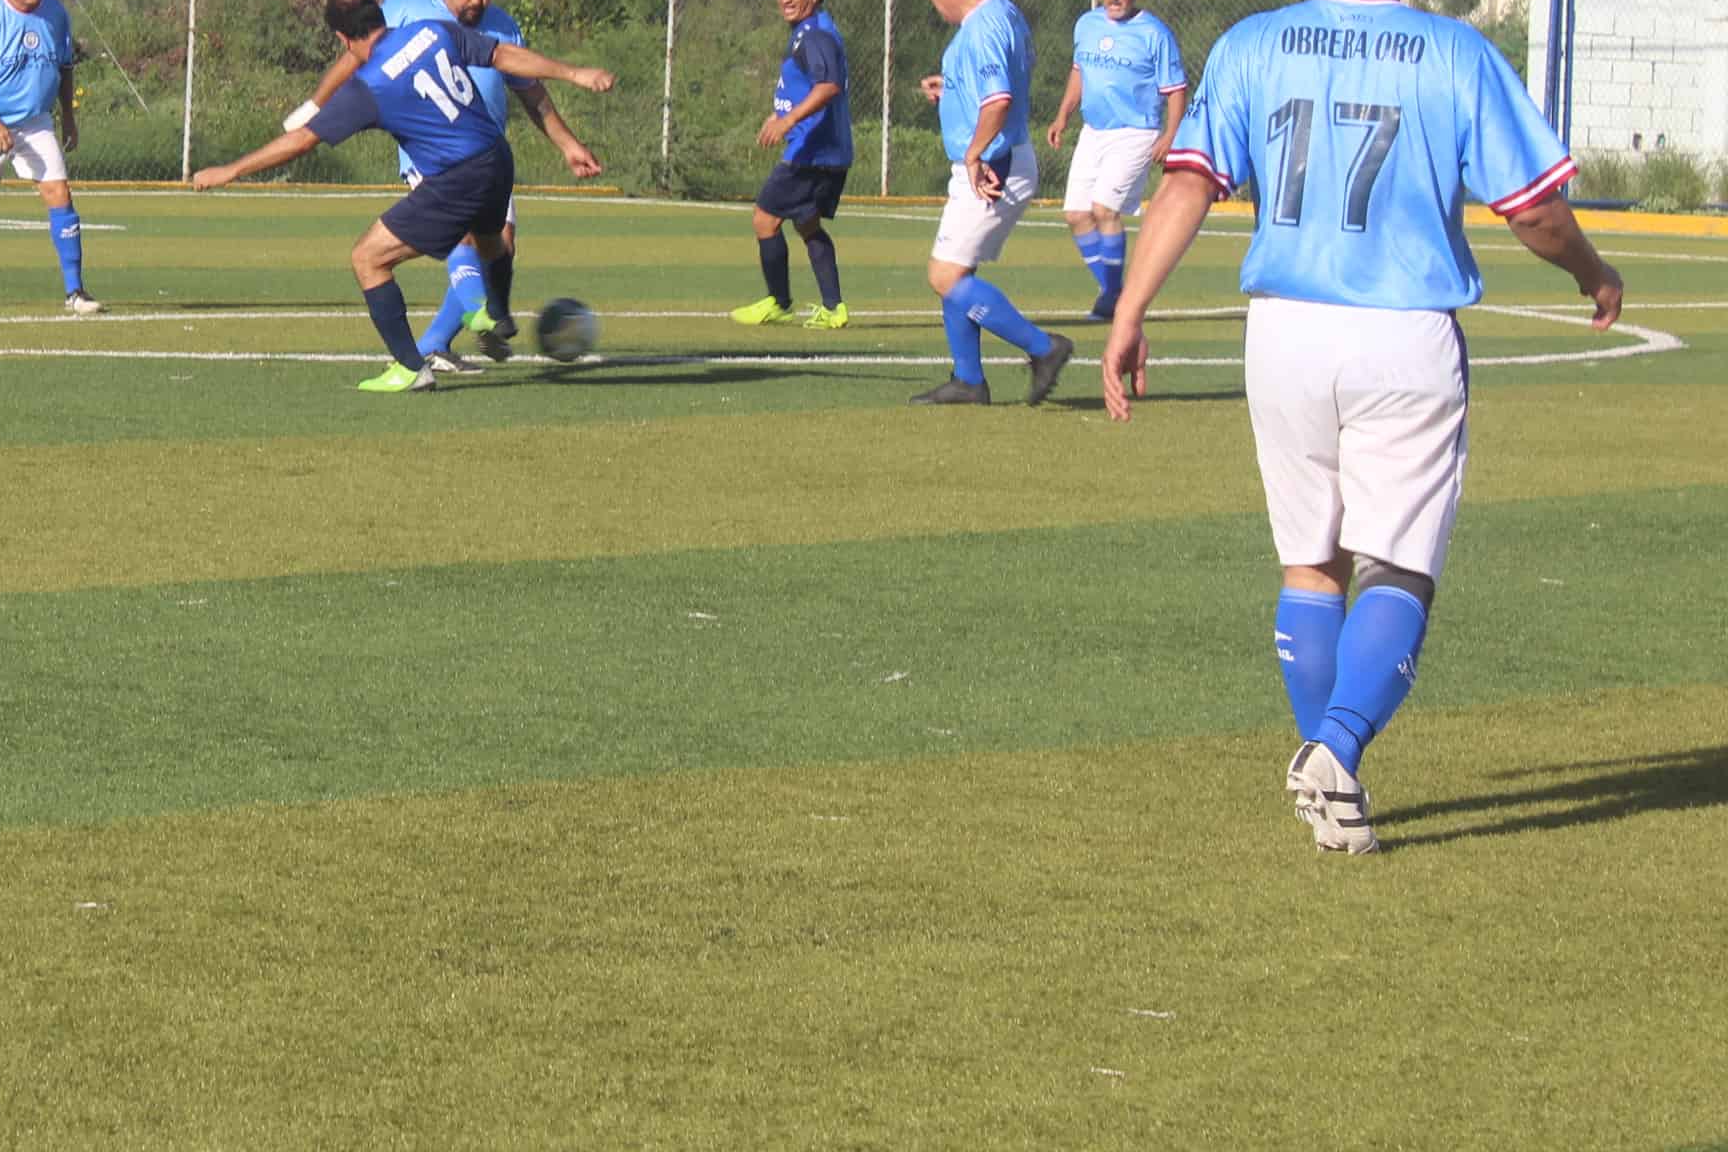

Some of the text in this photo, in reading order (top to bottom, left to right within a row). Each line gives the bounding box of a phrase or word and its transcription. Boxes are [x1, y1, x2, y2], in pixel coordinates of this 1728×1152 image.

[1281, 25, 1426, 65] OBRERA ORO
[413, 47, 474, 123] 16
[1266, 97, 1402, 233] 17
